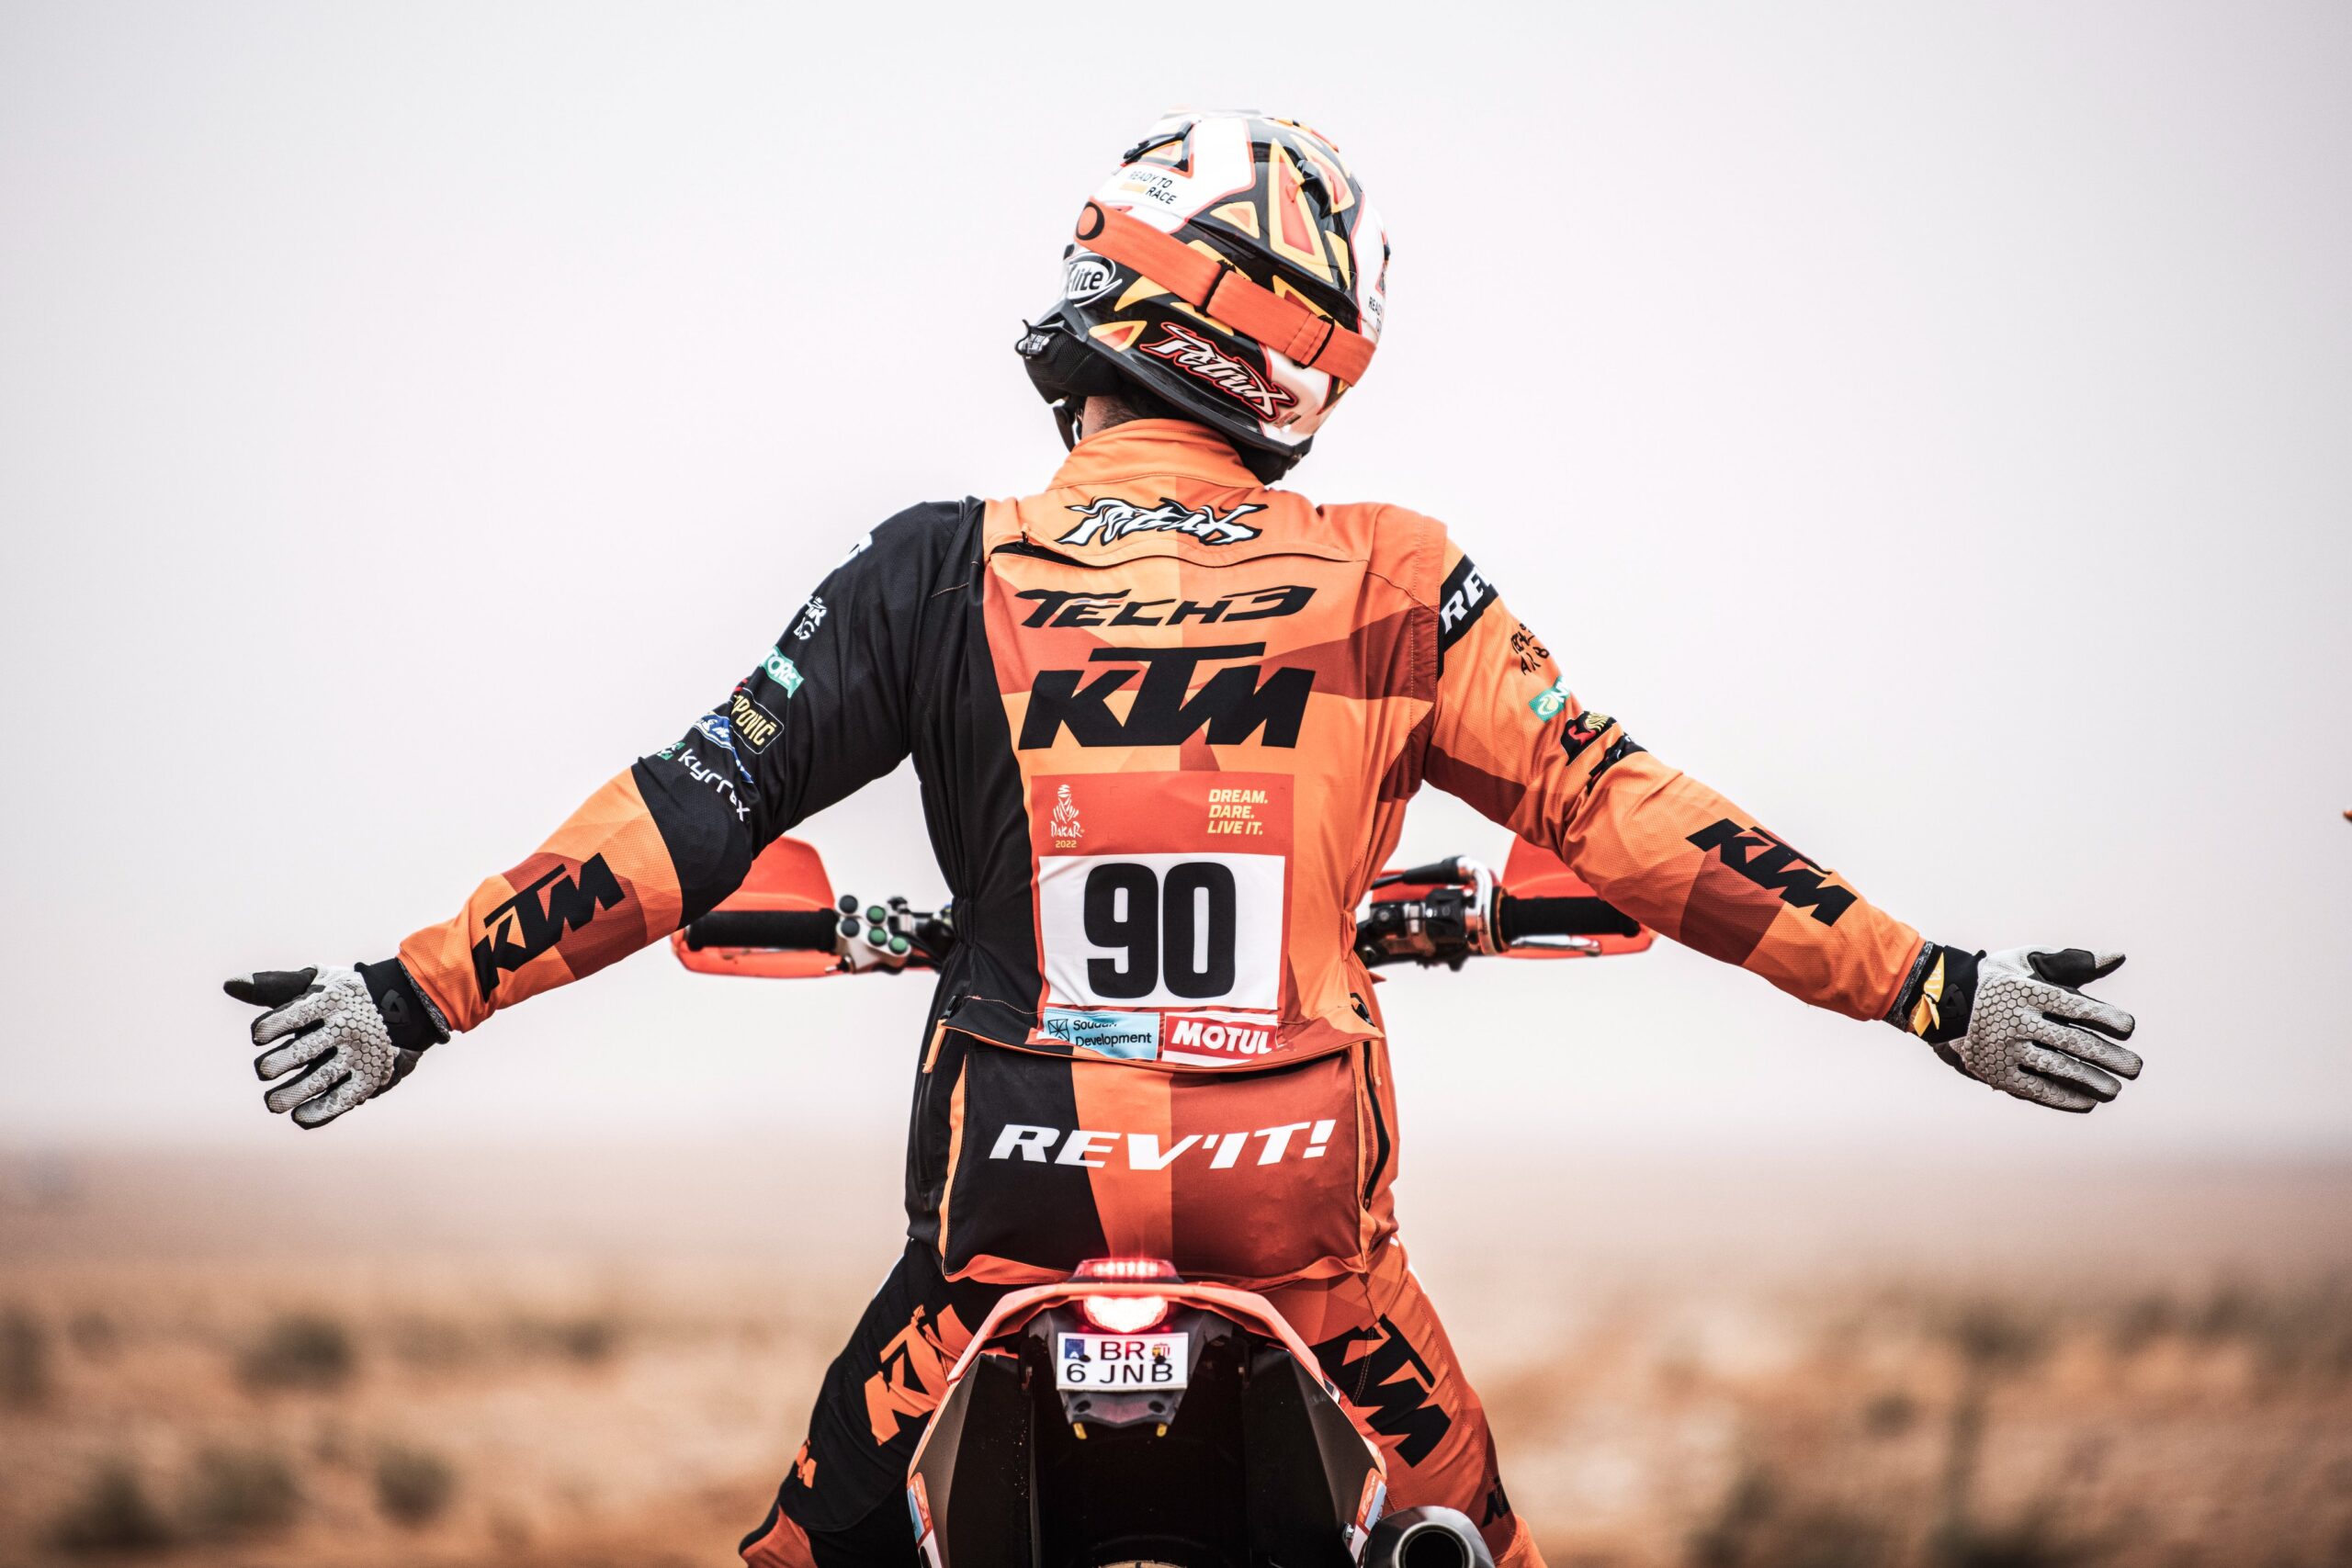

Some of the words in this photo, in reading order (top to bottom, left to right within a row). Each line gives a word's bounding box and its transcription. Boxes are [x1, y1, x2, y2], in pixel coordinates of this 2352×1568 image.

[1158, 177, 1173, 188] TO
[1146, 186, 1177, 205] RACE
[1015, 585, 1317, 627] TECH3
[1018, 642, 1316, 750] KTM
[1208, 788, 1269, 805] DREAM.
[1208, 804, 1255, 819] DARE.
[1206, 820, 1244, 834] LIVE
[1245, 821, 1263, 836] IT.
[1055, 840, 1078, 849] 2022
[1685, 818, 1858, 927] KTM
[471, 852, 626, 1003] KTM
[1083, 862, 1237, 999] 90
[1075, 1032, 1152, 1047] Development
[1170, 1020, 1272, 1055] MOTUL
[989, 1119, 1337, 1170] REV'IT!
[1100, 1341, 1146, 1360] BR
[1066, 1363, 1086, 1382] 6
[1099, 1363, 1172, 1384] JNB
